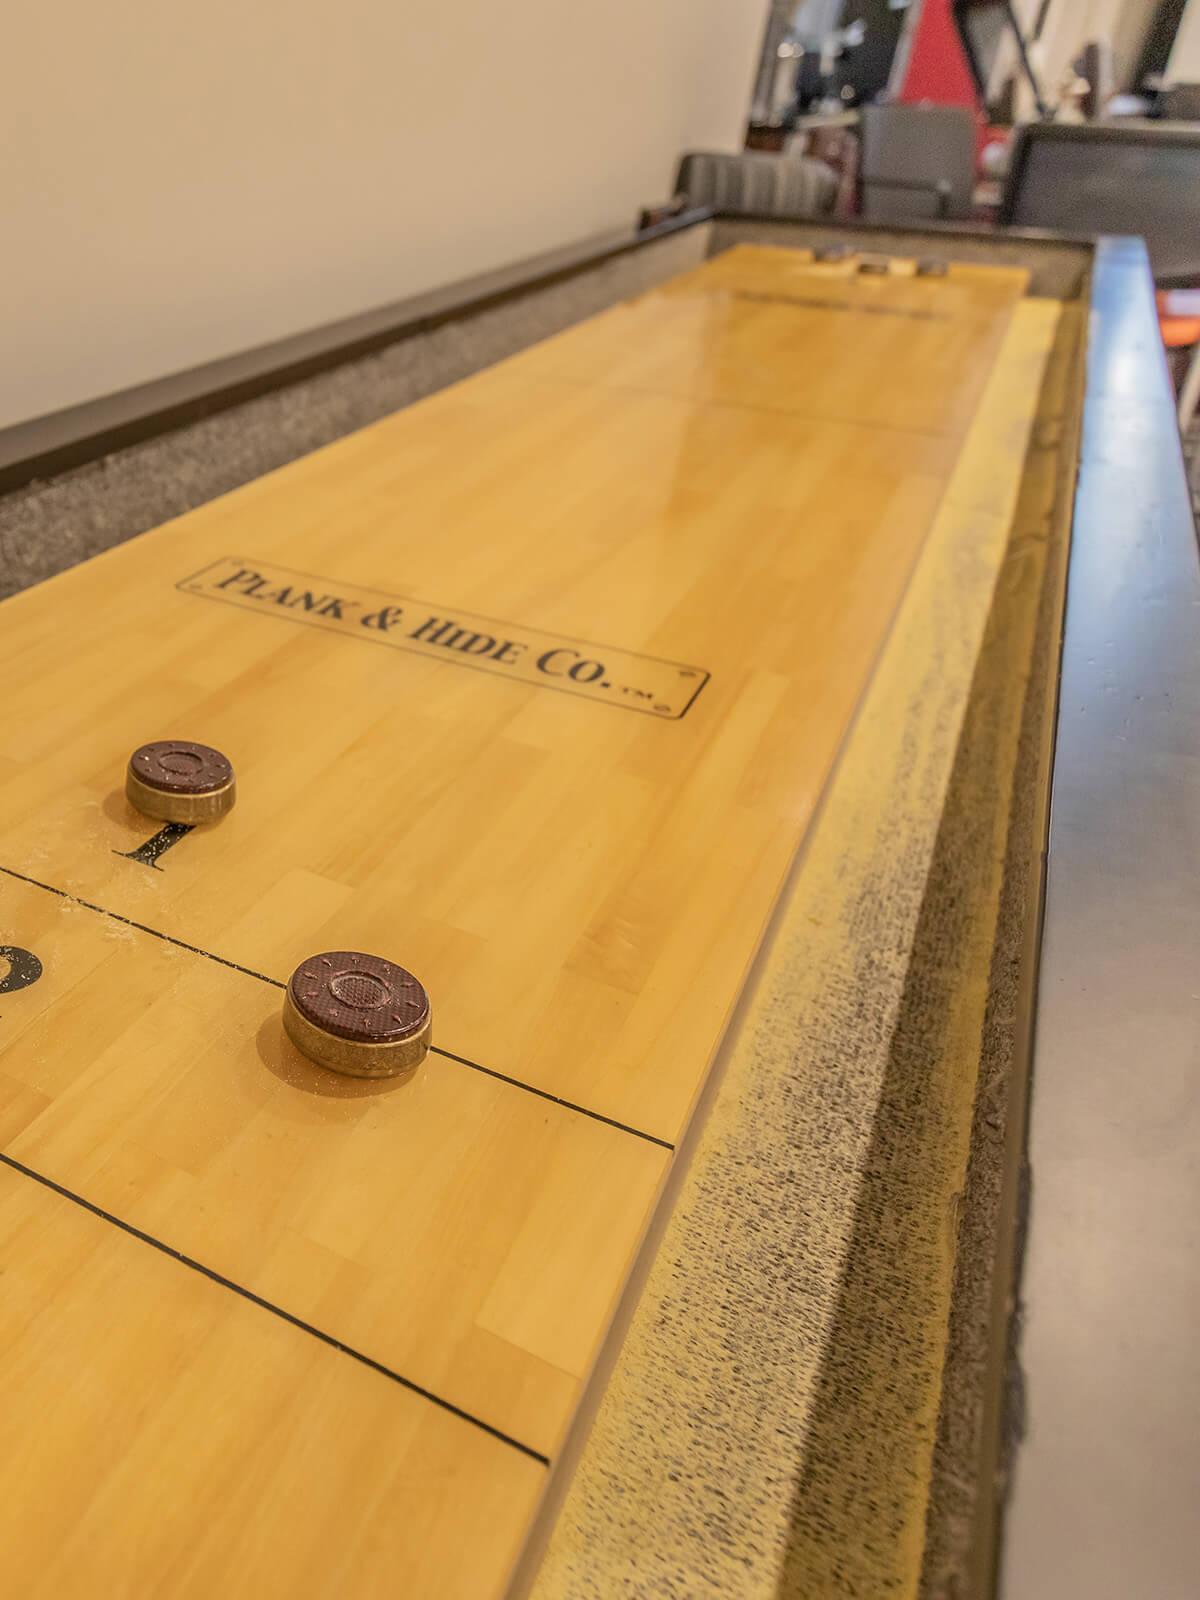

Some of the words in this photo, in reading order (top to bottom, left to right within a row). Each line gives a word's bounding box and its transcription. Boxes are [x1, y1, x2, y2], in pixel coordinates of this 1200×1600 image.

[214, 568, 359, 620] PLANK
[360, 606, 403, 632] &
[406, 616, 528, 665] HIDE
